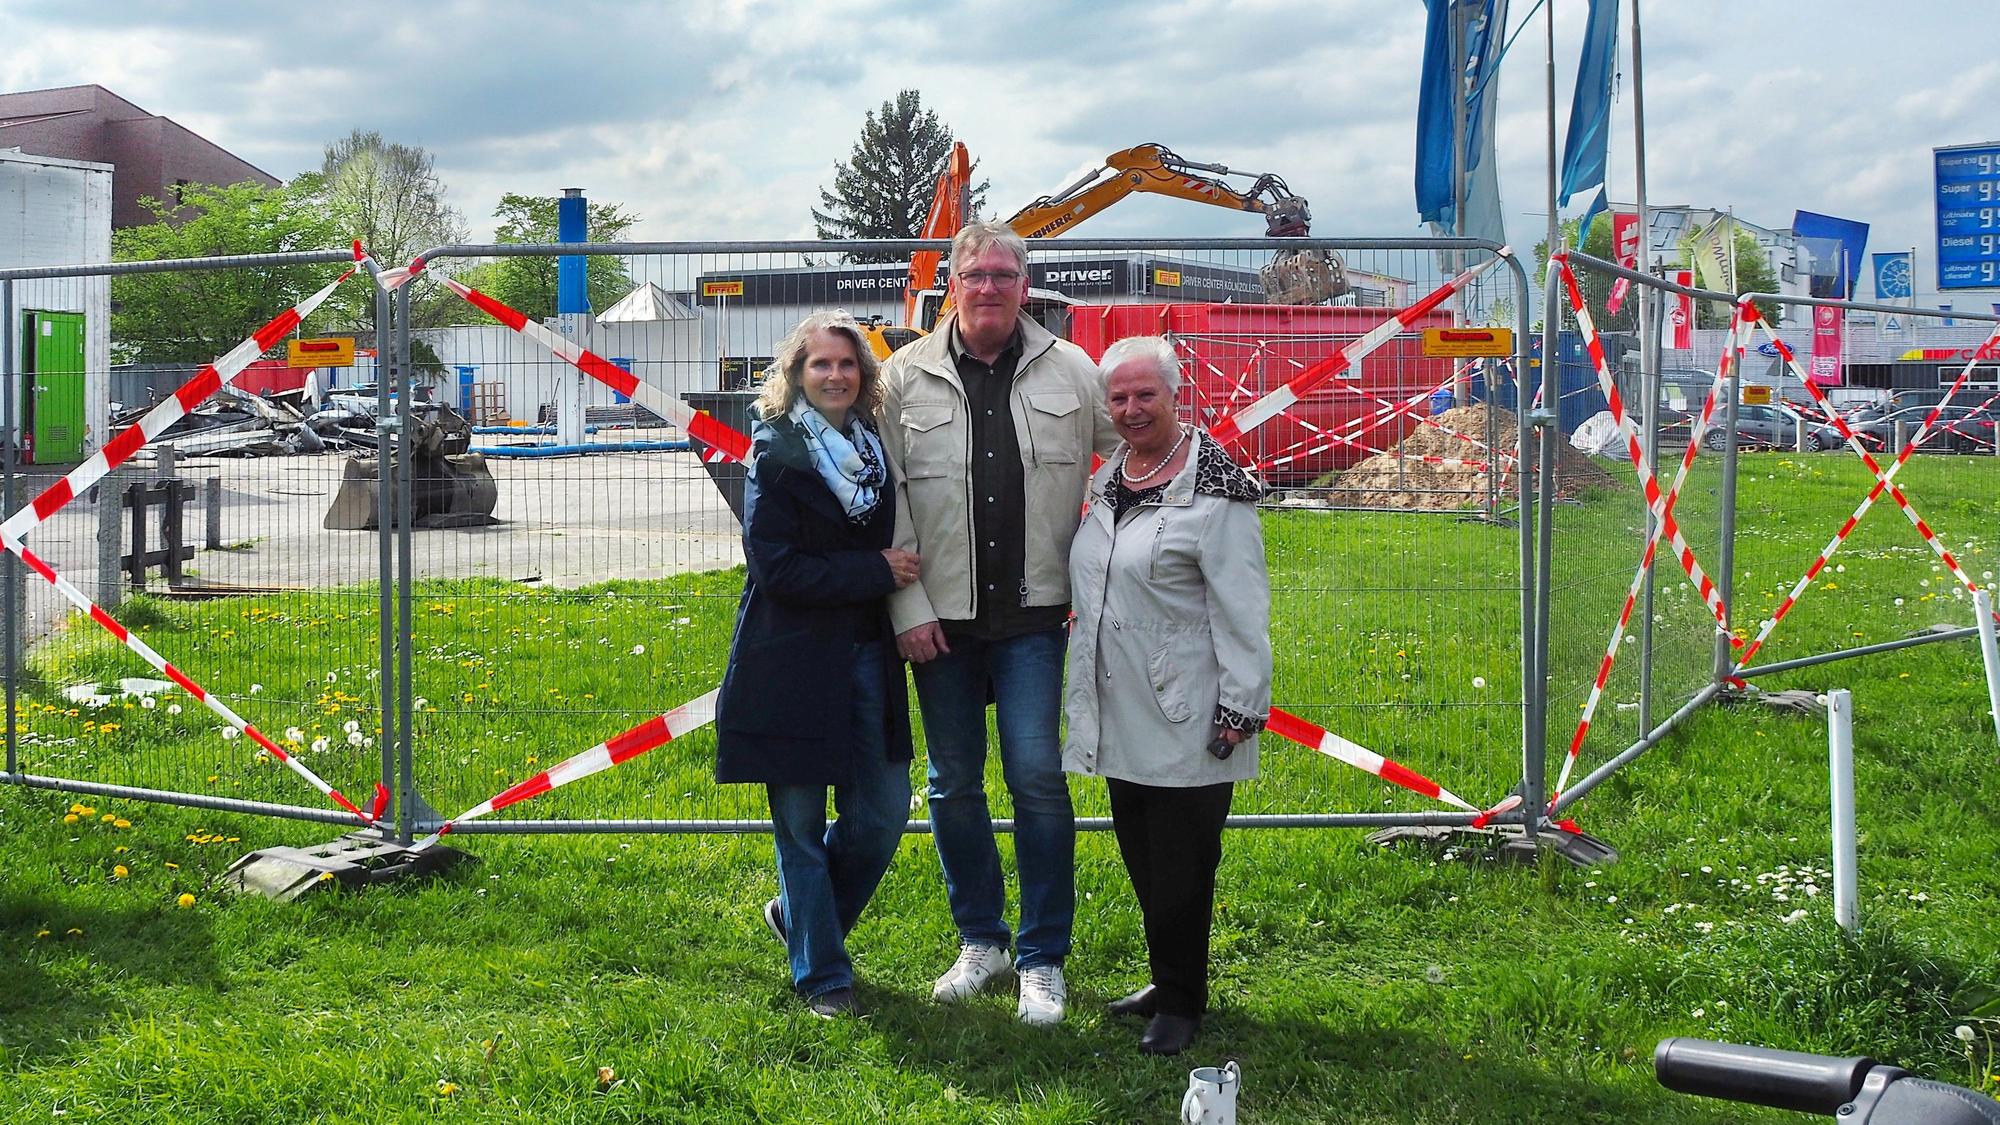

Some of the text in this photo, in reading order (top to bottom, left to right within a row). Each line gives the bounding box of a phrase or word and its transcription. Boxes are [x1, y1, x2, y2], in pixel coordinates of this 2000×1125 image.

[1941, 185, 1970, 194] Super
[1942, 236, 1974, 247] Diesel
[837, 278, 876, 290] DRIVER
[878, 277, 908, 288] CENT
[568, 325, 574, 333] 9
